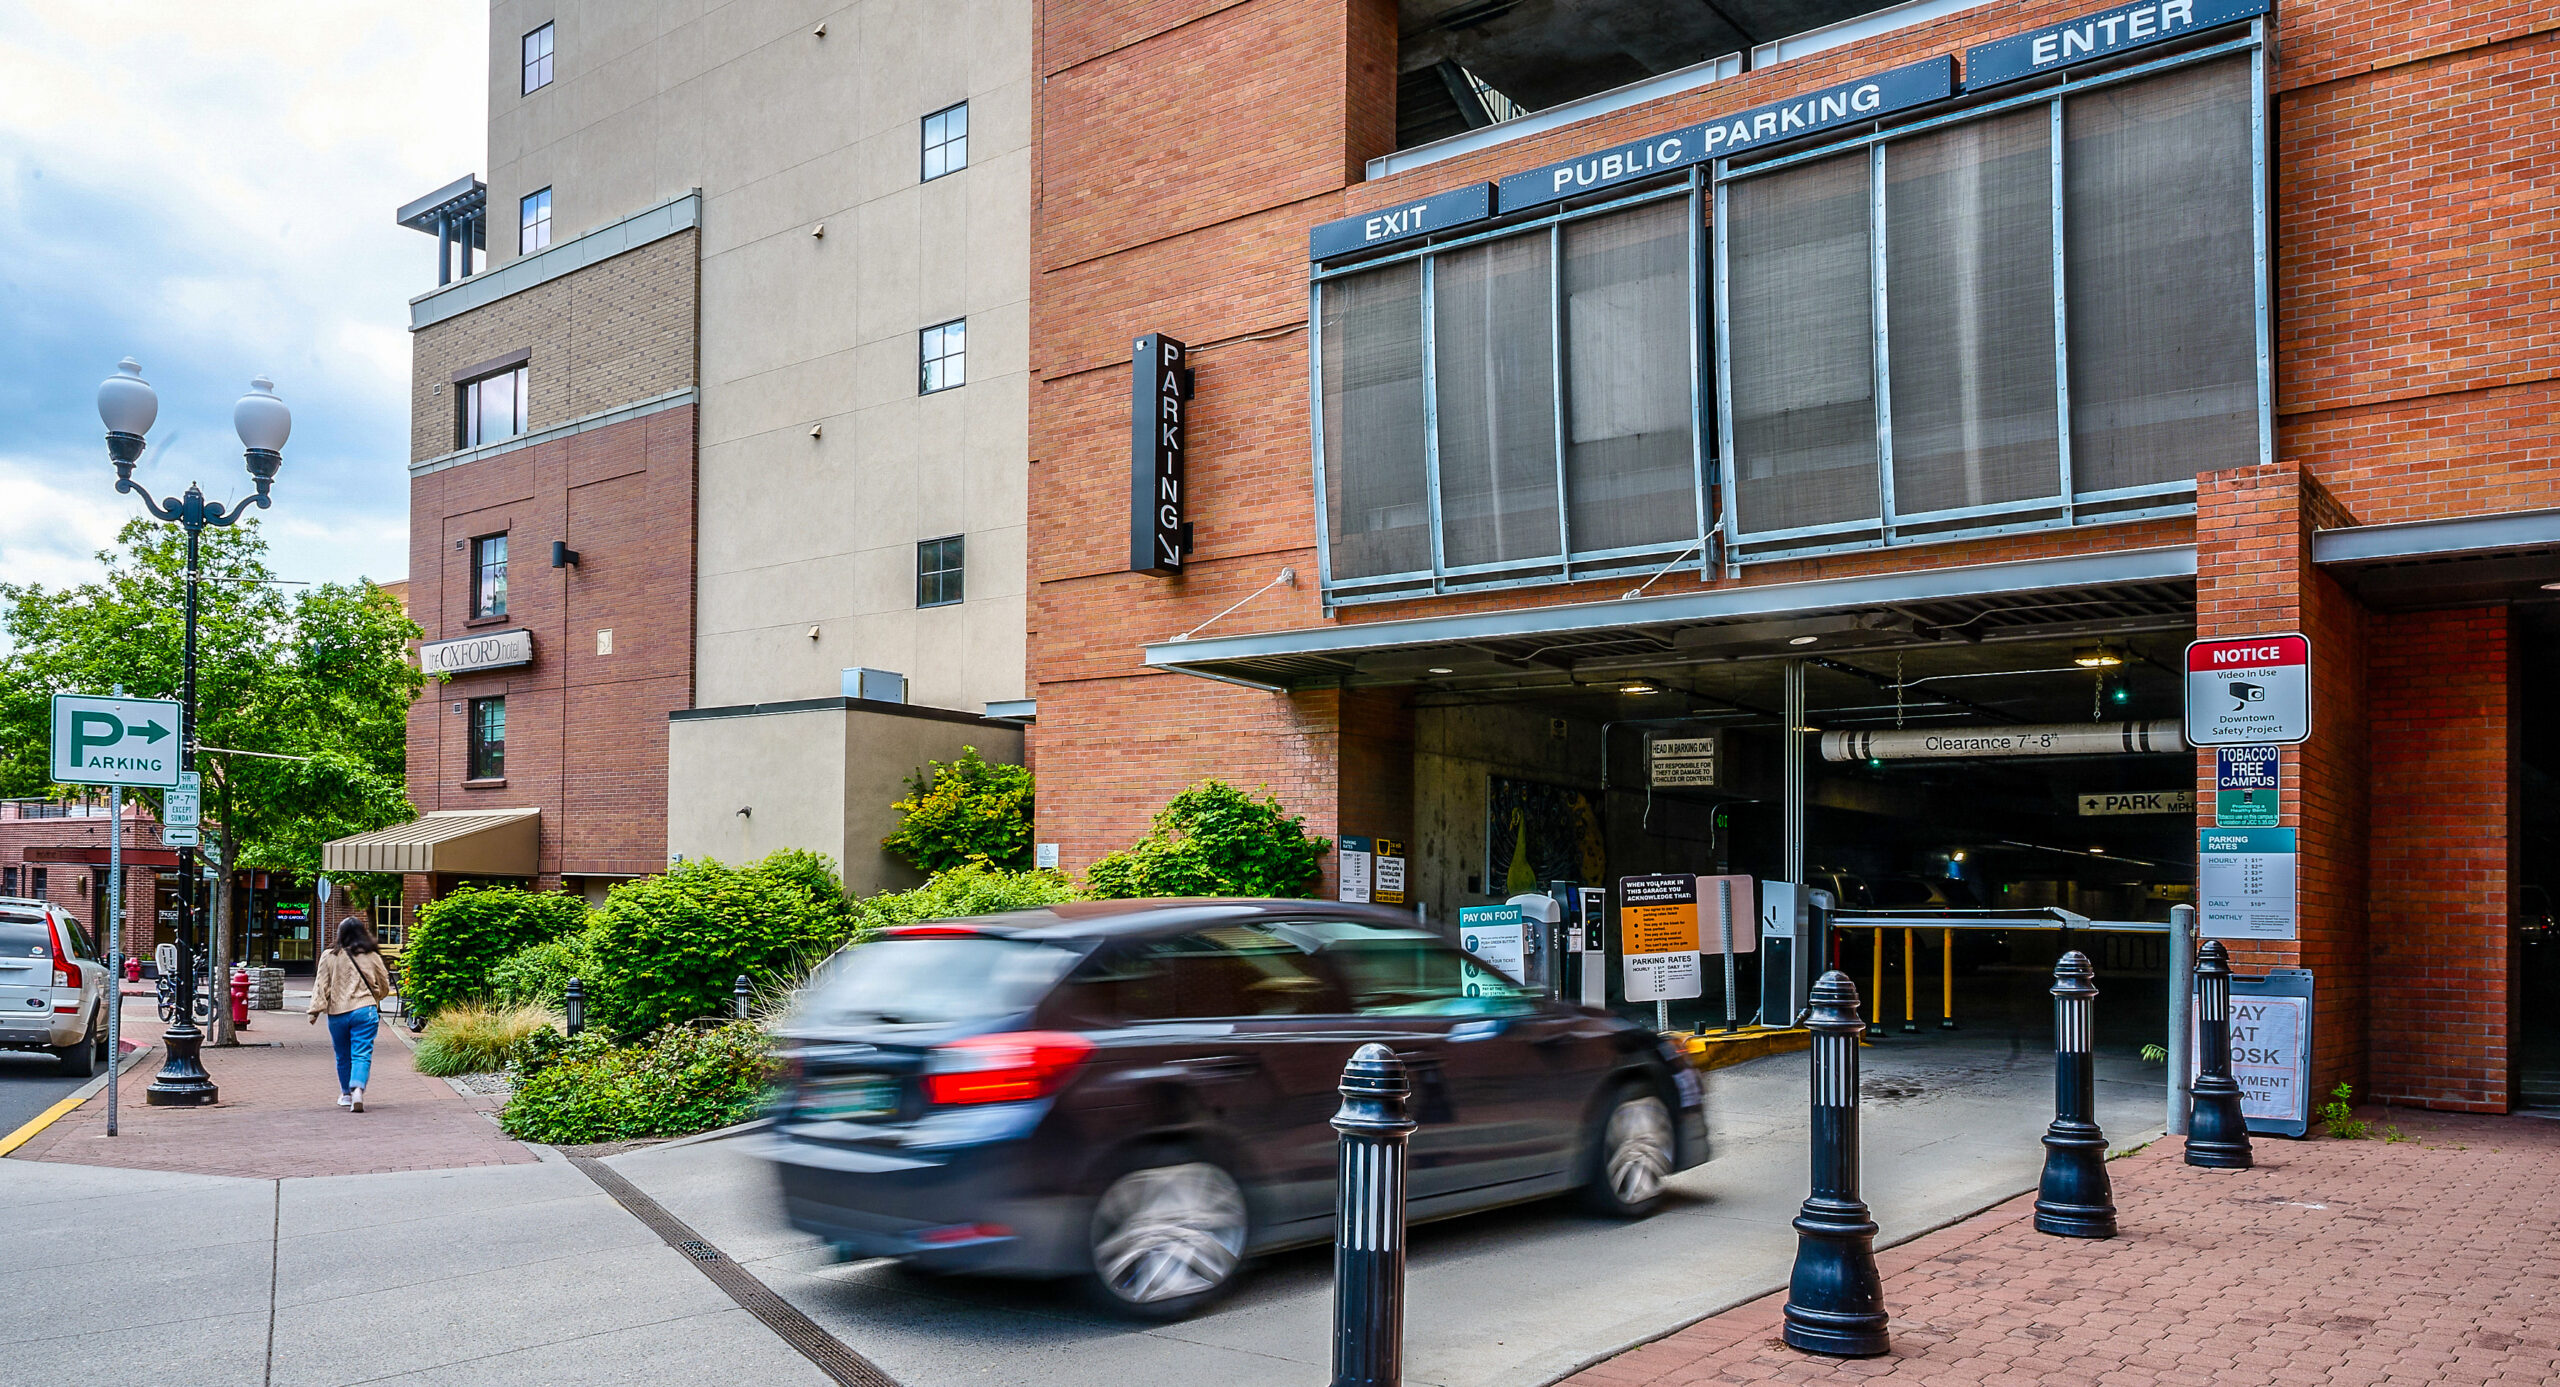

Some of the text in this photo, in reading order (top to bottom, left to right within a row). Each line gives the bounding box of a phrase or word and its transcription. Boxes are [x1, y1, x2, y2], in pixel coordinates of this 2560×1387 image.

[2032, 0, 2193, 65] ENTER
[1554, 84, 1880, 192] PUBLIC PARKING
[1366, 205, 1427, 240] EXIT
[1160, 342, 1179, 529] PARKING
[429, 640, 520, 669] the OXFORD hotel
[2213, 646, 2280, 663] NOTICE
[2217, 669, 2277, 679] Video In Use
[2220, 714, 2275, 723] Downtown
[2212, 725, 2282, 736] Safety Project
[1653, 742, 1712, 754] HEAD IN PARKING ONLY
[1926, 736, 2011, 750] Clearance
[2221, 747, 2276, 762] TOBACCO
[2231, 763, 2264, 776] FREE
[2221, 776, 2275, 787] CAMPUS
[2106, 794, 2162, 810] PARK
[2176, 792, 2185, 801] 5
[2168, 802, 2194, 812] MPH
[1463, 910, 1518, 922] PAY ON FOOT
[1632, 955, 1692, 965] PARKING RATES
[2231, 1026, 2259, 1042] AT
[2231, 1047, 2280, 1065] OSK
[2237, 1075, 2289, 1088] YMENT
[2244, 1091, 2272, 1101] ATE
